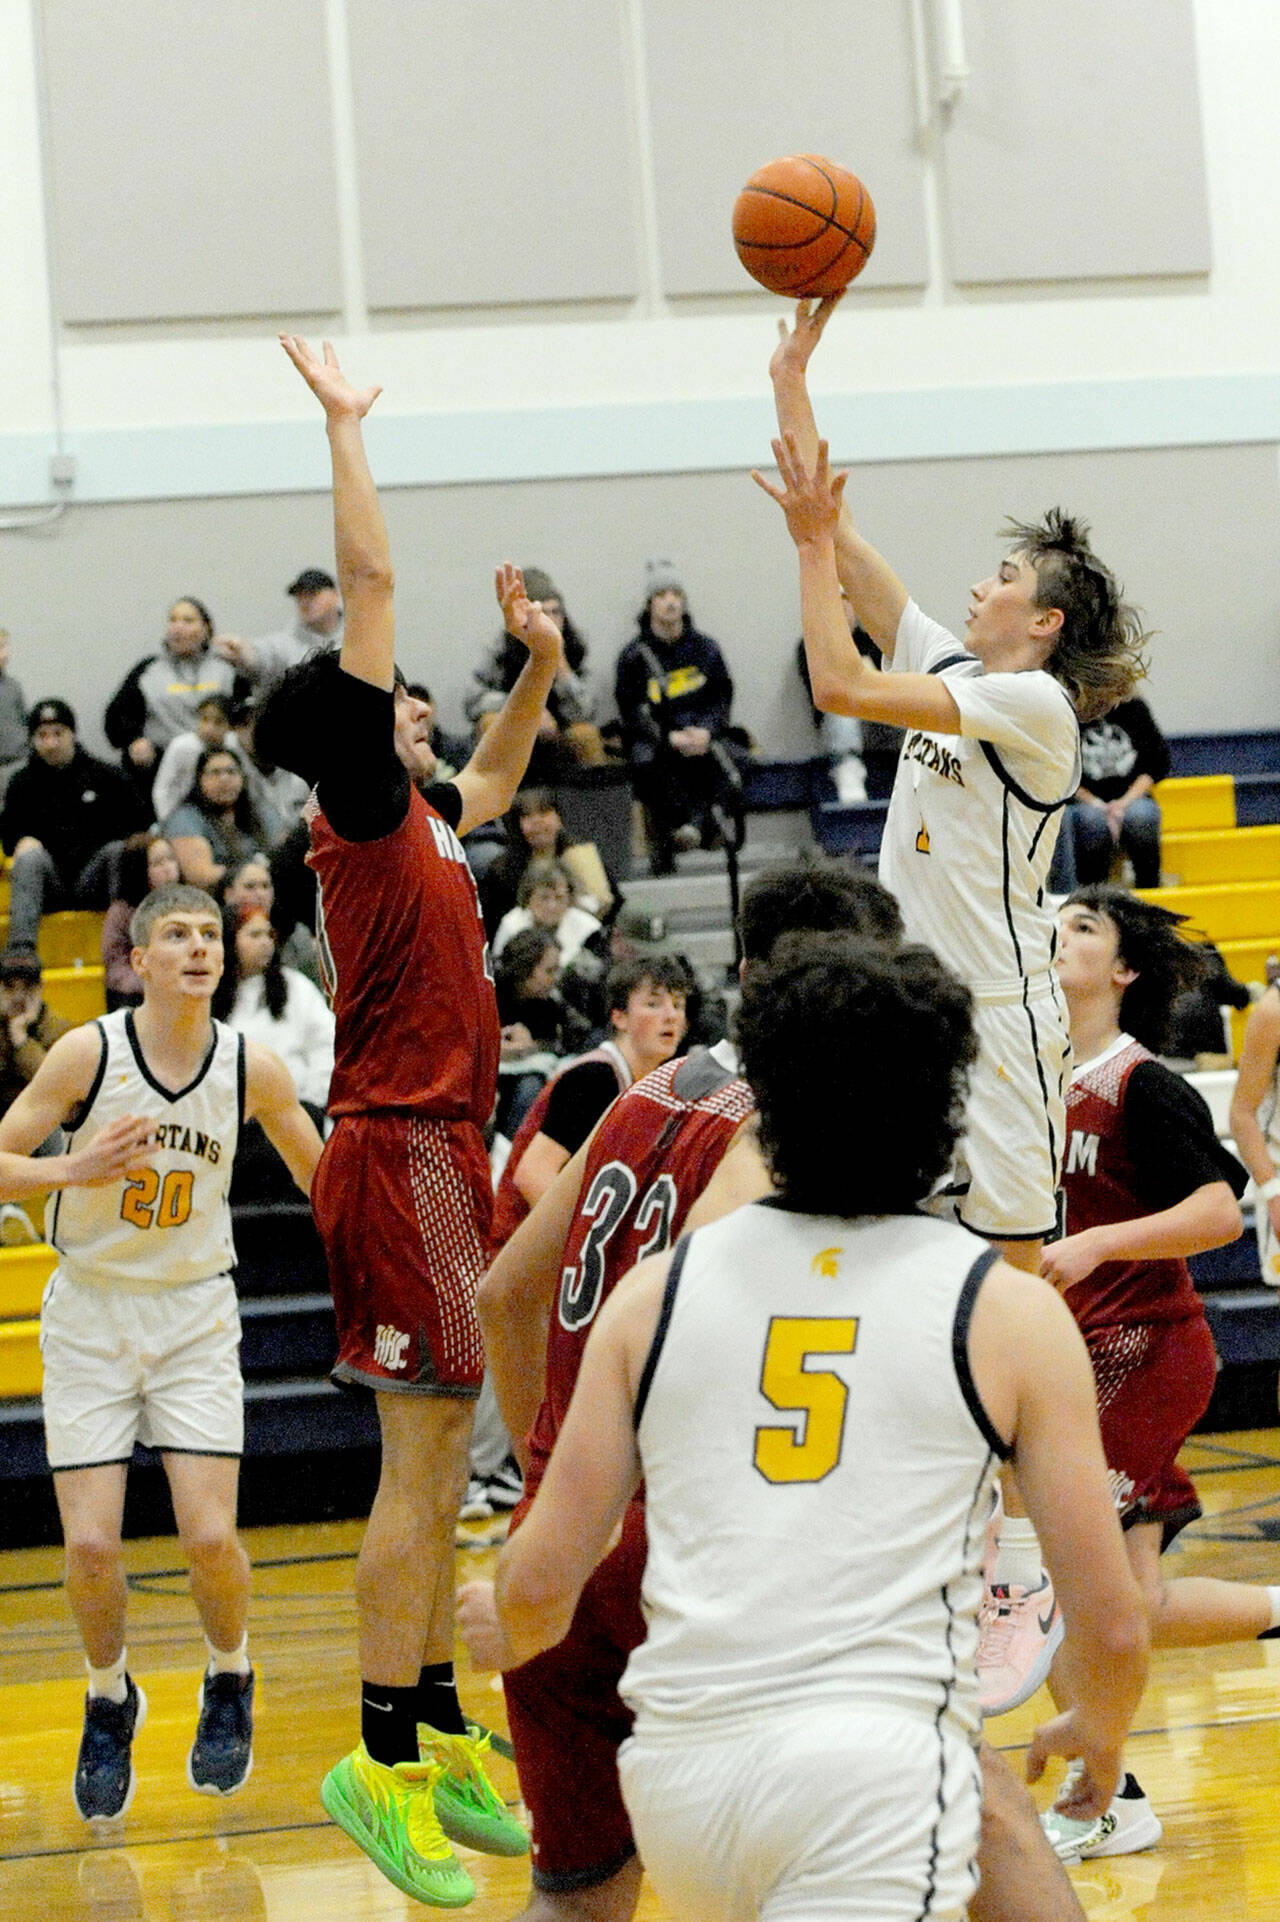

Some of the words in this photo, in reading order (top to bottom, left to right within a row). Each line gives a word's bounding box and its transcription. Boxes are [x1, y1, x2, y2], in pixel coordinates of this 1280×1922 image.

[136, 1123, 221, 1165] RTANS
[120, 1167, 195, 1229] 20
[753, 1315, 860, 1485] 5
